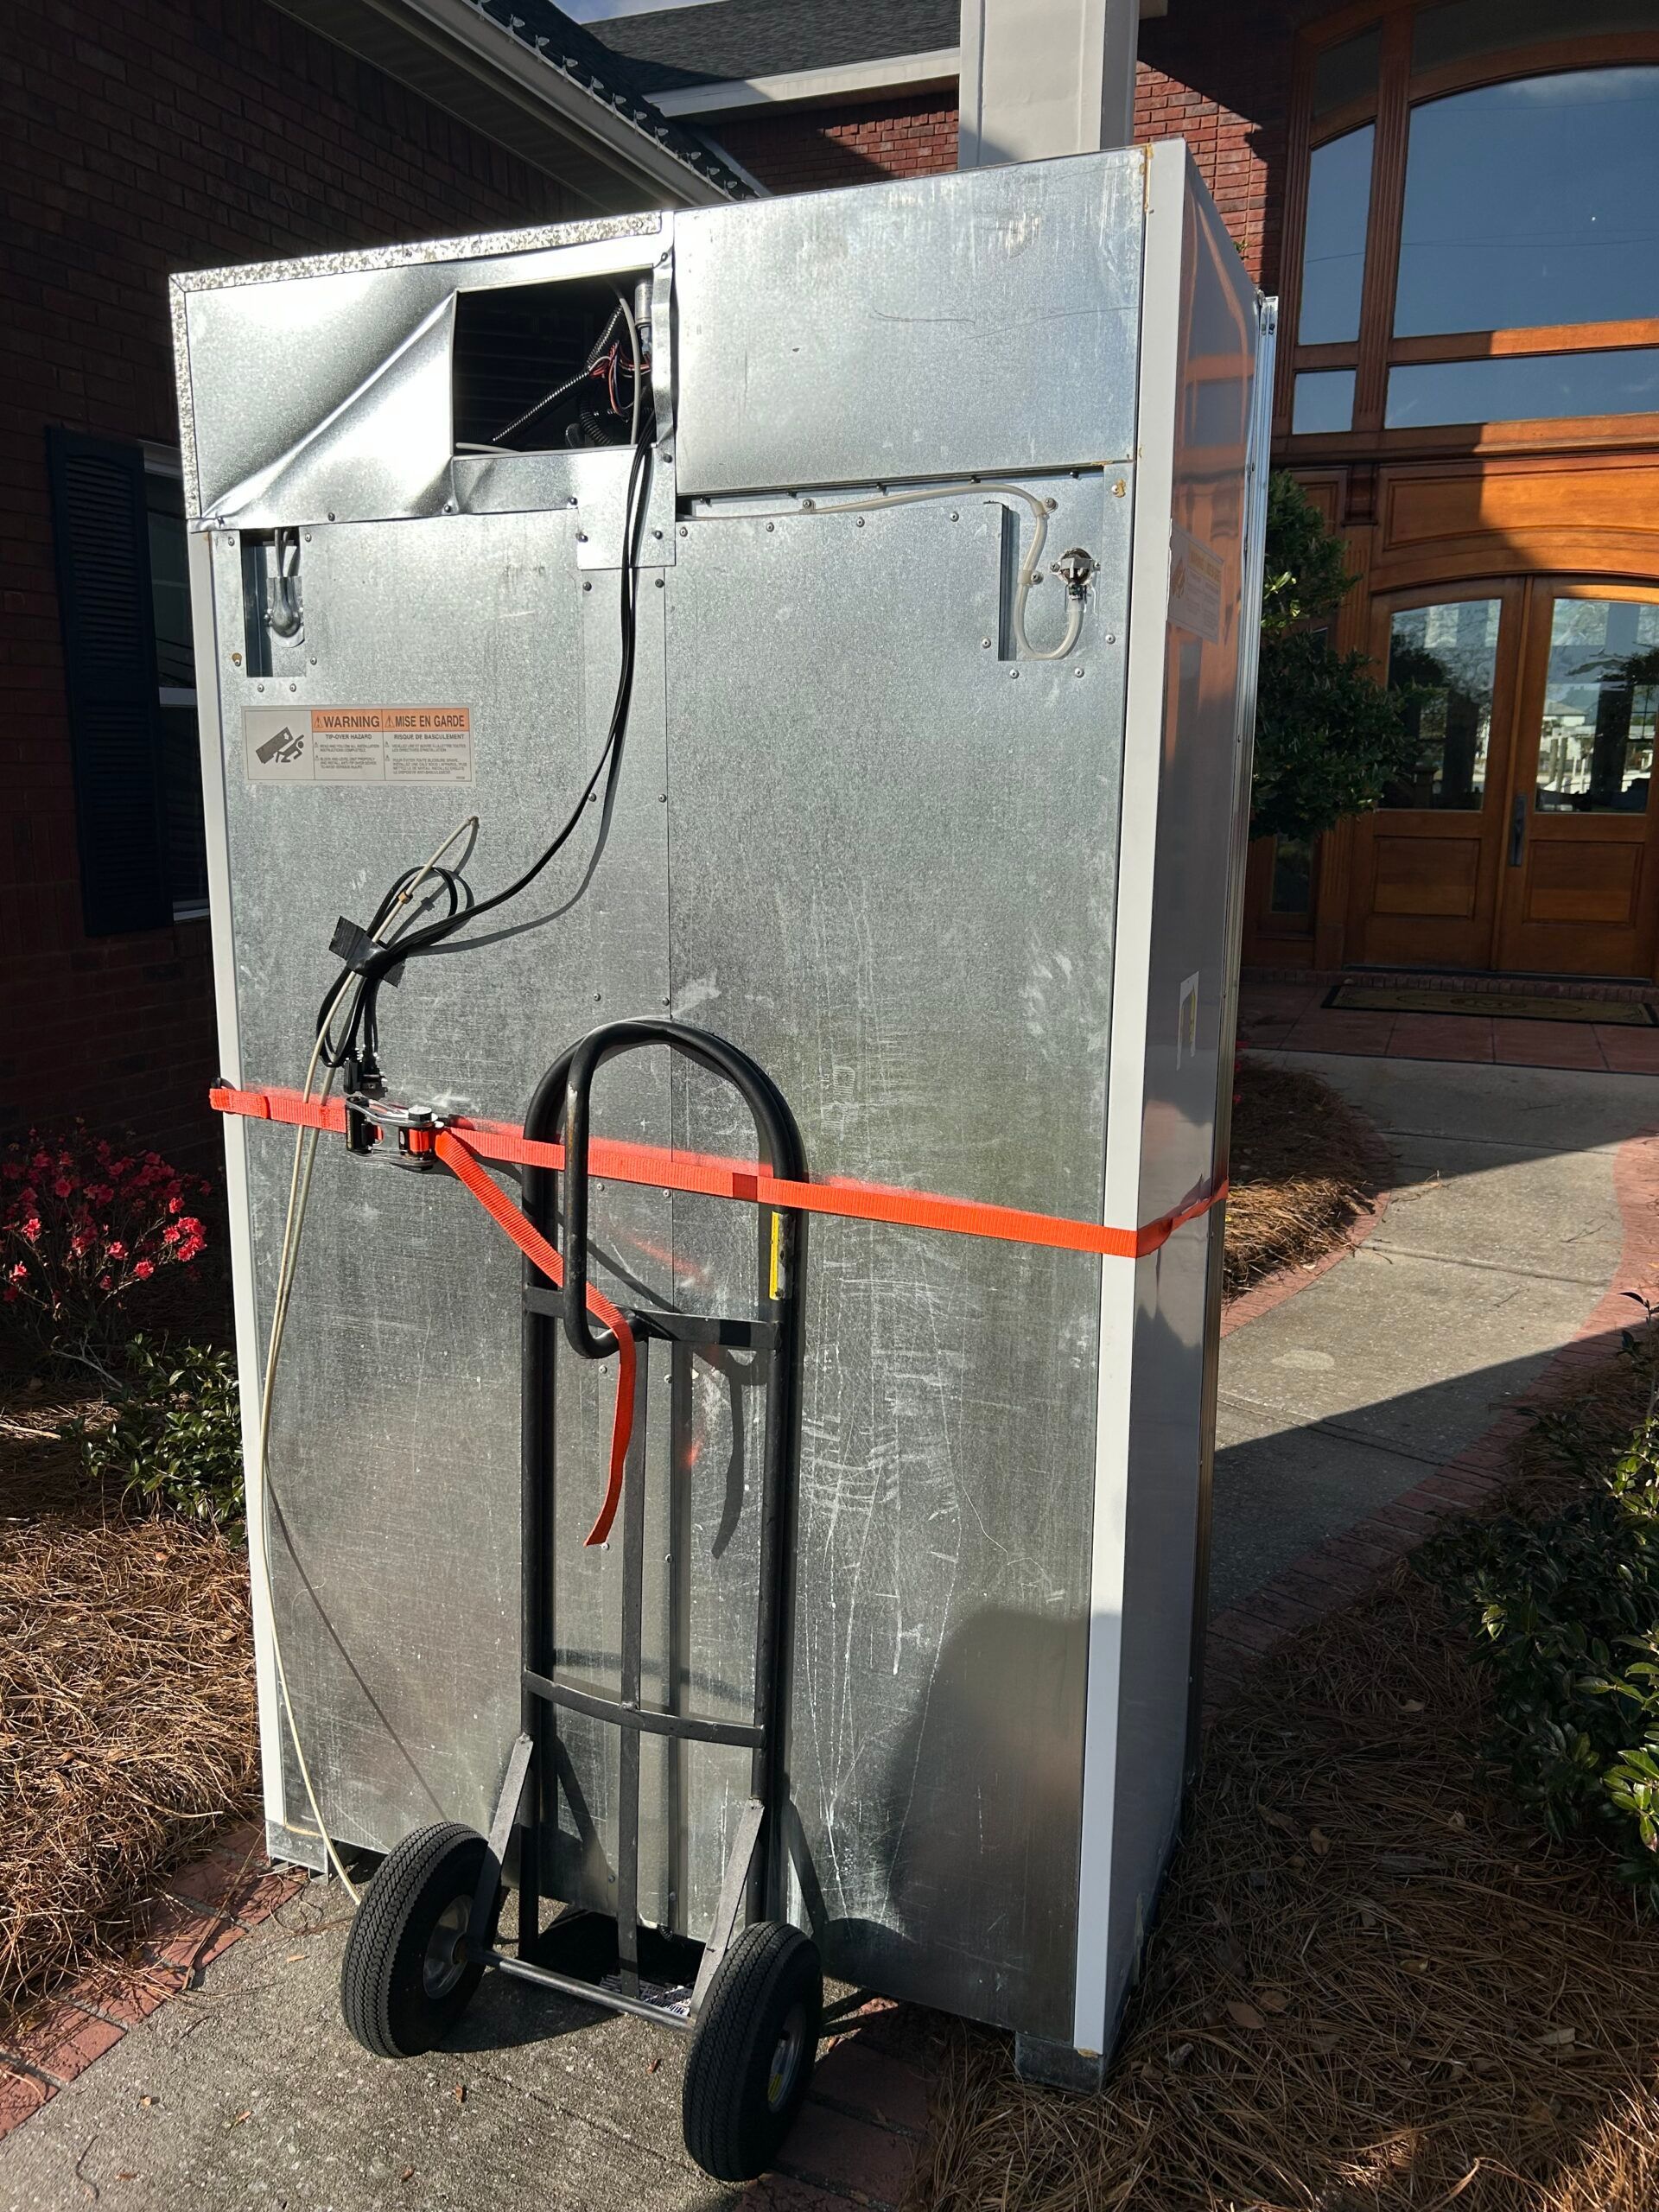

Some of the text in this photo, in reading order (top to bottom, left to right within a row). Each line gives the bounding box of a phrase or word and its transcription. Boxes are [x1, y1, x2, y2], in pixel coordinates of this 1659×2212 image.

[323, 715, 380, 728] WARNING
[395, 715, 465, 728] MISE EN GARDE
